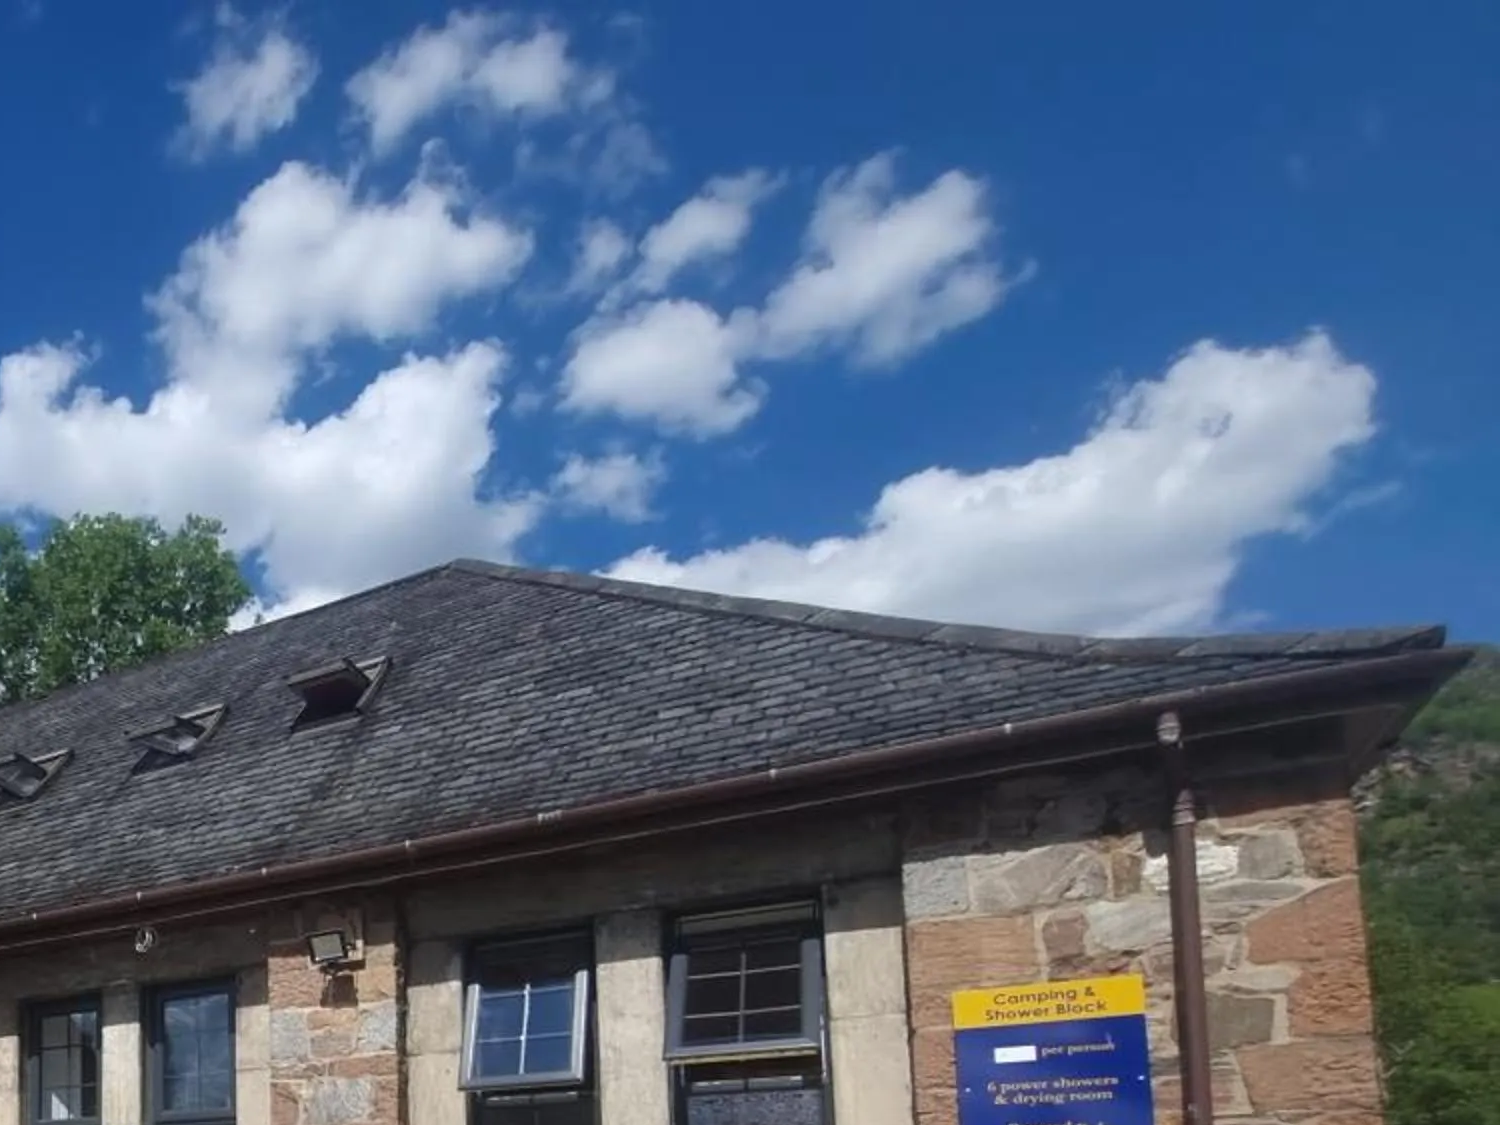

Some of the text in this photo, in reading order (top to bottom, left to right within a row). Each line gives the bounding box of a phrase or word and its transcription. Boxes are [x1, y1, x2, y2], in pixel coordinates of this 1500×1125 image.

[993, 985, 1095, 1005] Camping &
[985, 1000, 1108, 1021] Shower Block
[1041, 1047, 1062, 1057] per
[1000, 1081, 1047, 1094] power
[1053, 1077, 1119, 1090] showers
[994, 1091, 1113, 1107] & drying room
